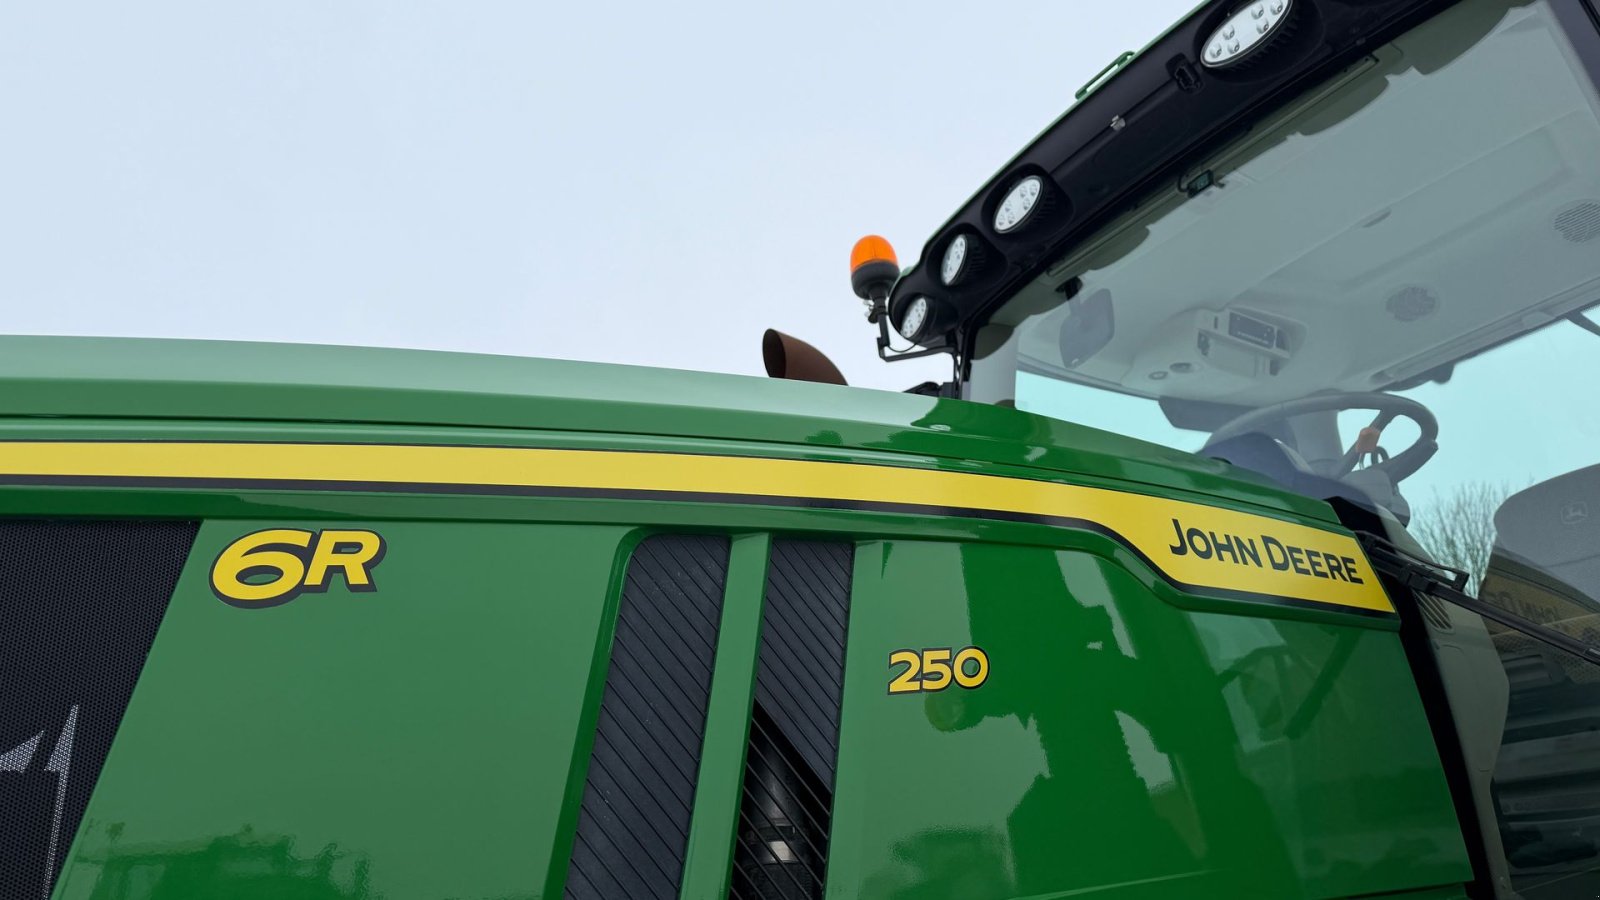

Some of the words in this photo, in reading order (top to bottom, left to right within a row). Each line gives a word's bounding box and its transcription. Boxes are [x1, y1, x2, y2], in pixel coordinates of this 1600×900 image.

[210, 528, 386, 608] 6R
[1168, 518, 1263, 568] JOHN
[1260, 534, 1364, 585] DEERE
[888, 647, 989, 694] 250
